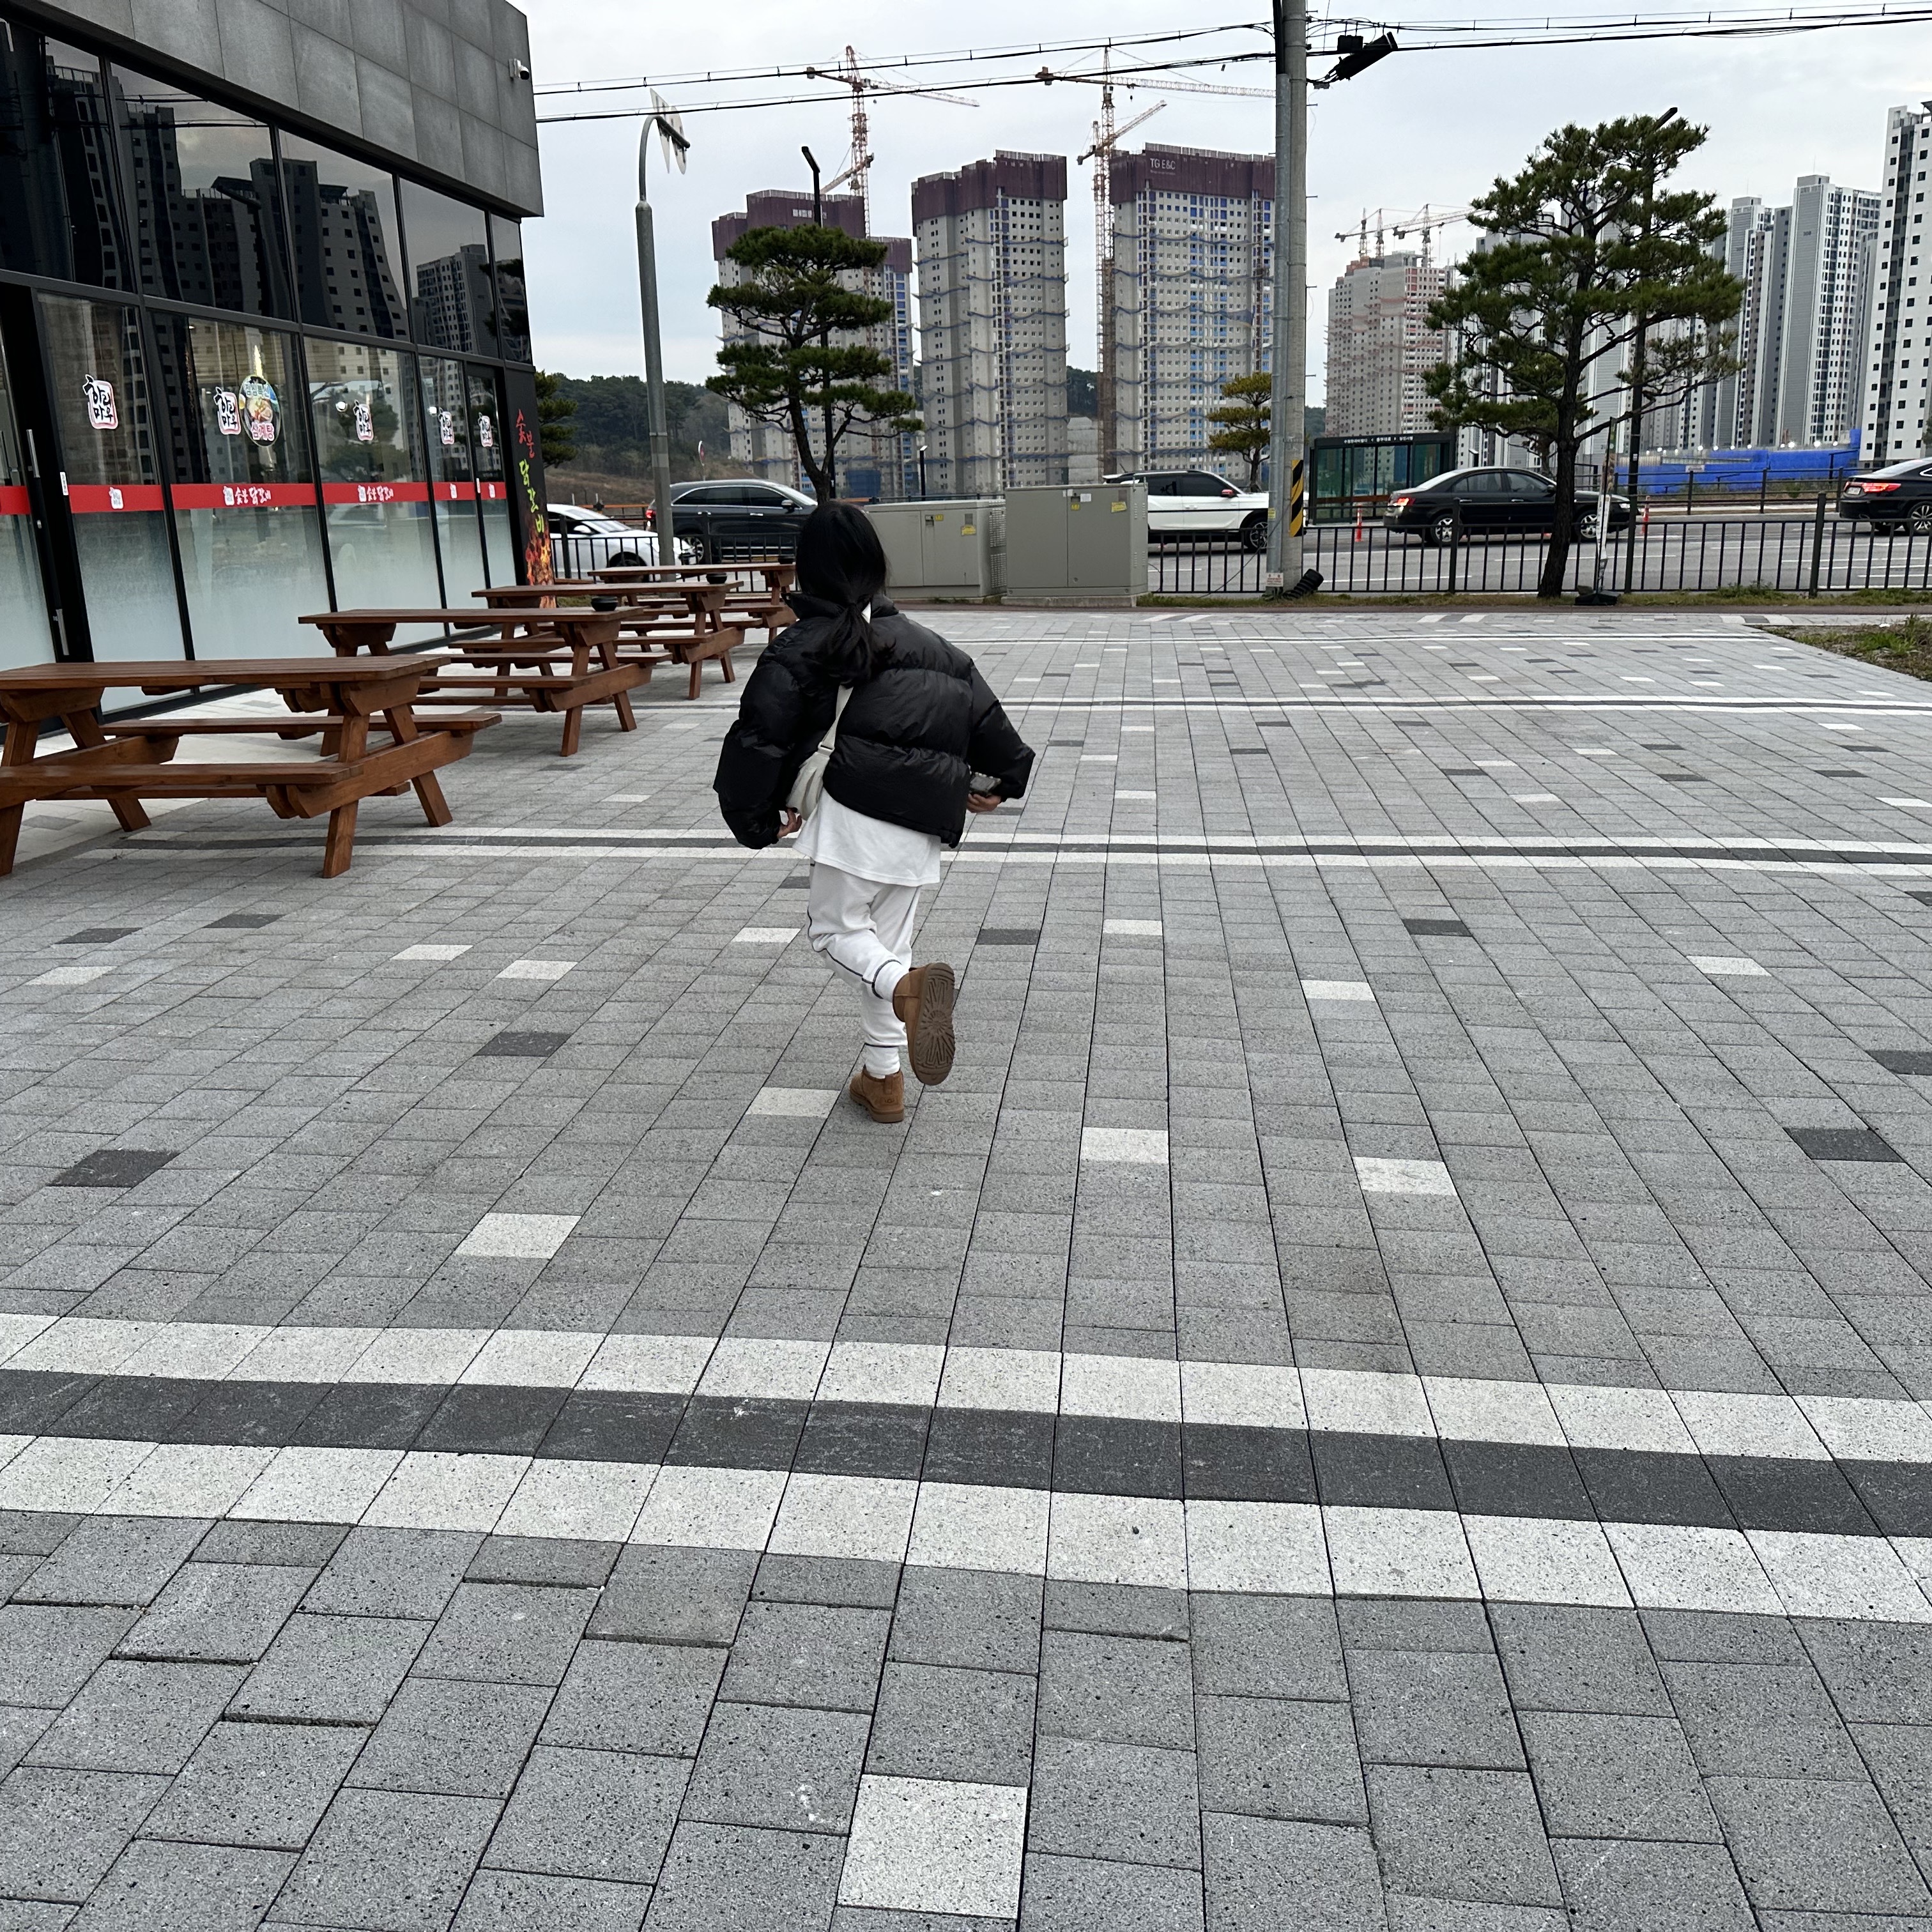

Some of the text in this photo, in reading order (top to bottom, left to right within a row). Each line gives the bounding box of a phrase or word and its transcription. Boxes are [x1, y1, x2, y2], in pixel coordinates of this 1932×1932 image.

[1150, 157, 1176, 170] TG E&C
[251, 423, 275, 440] 삼계탕
